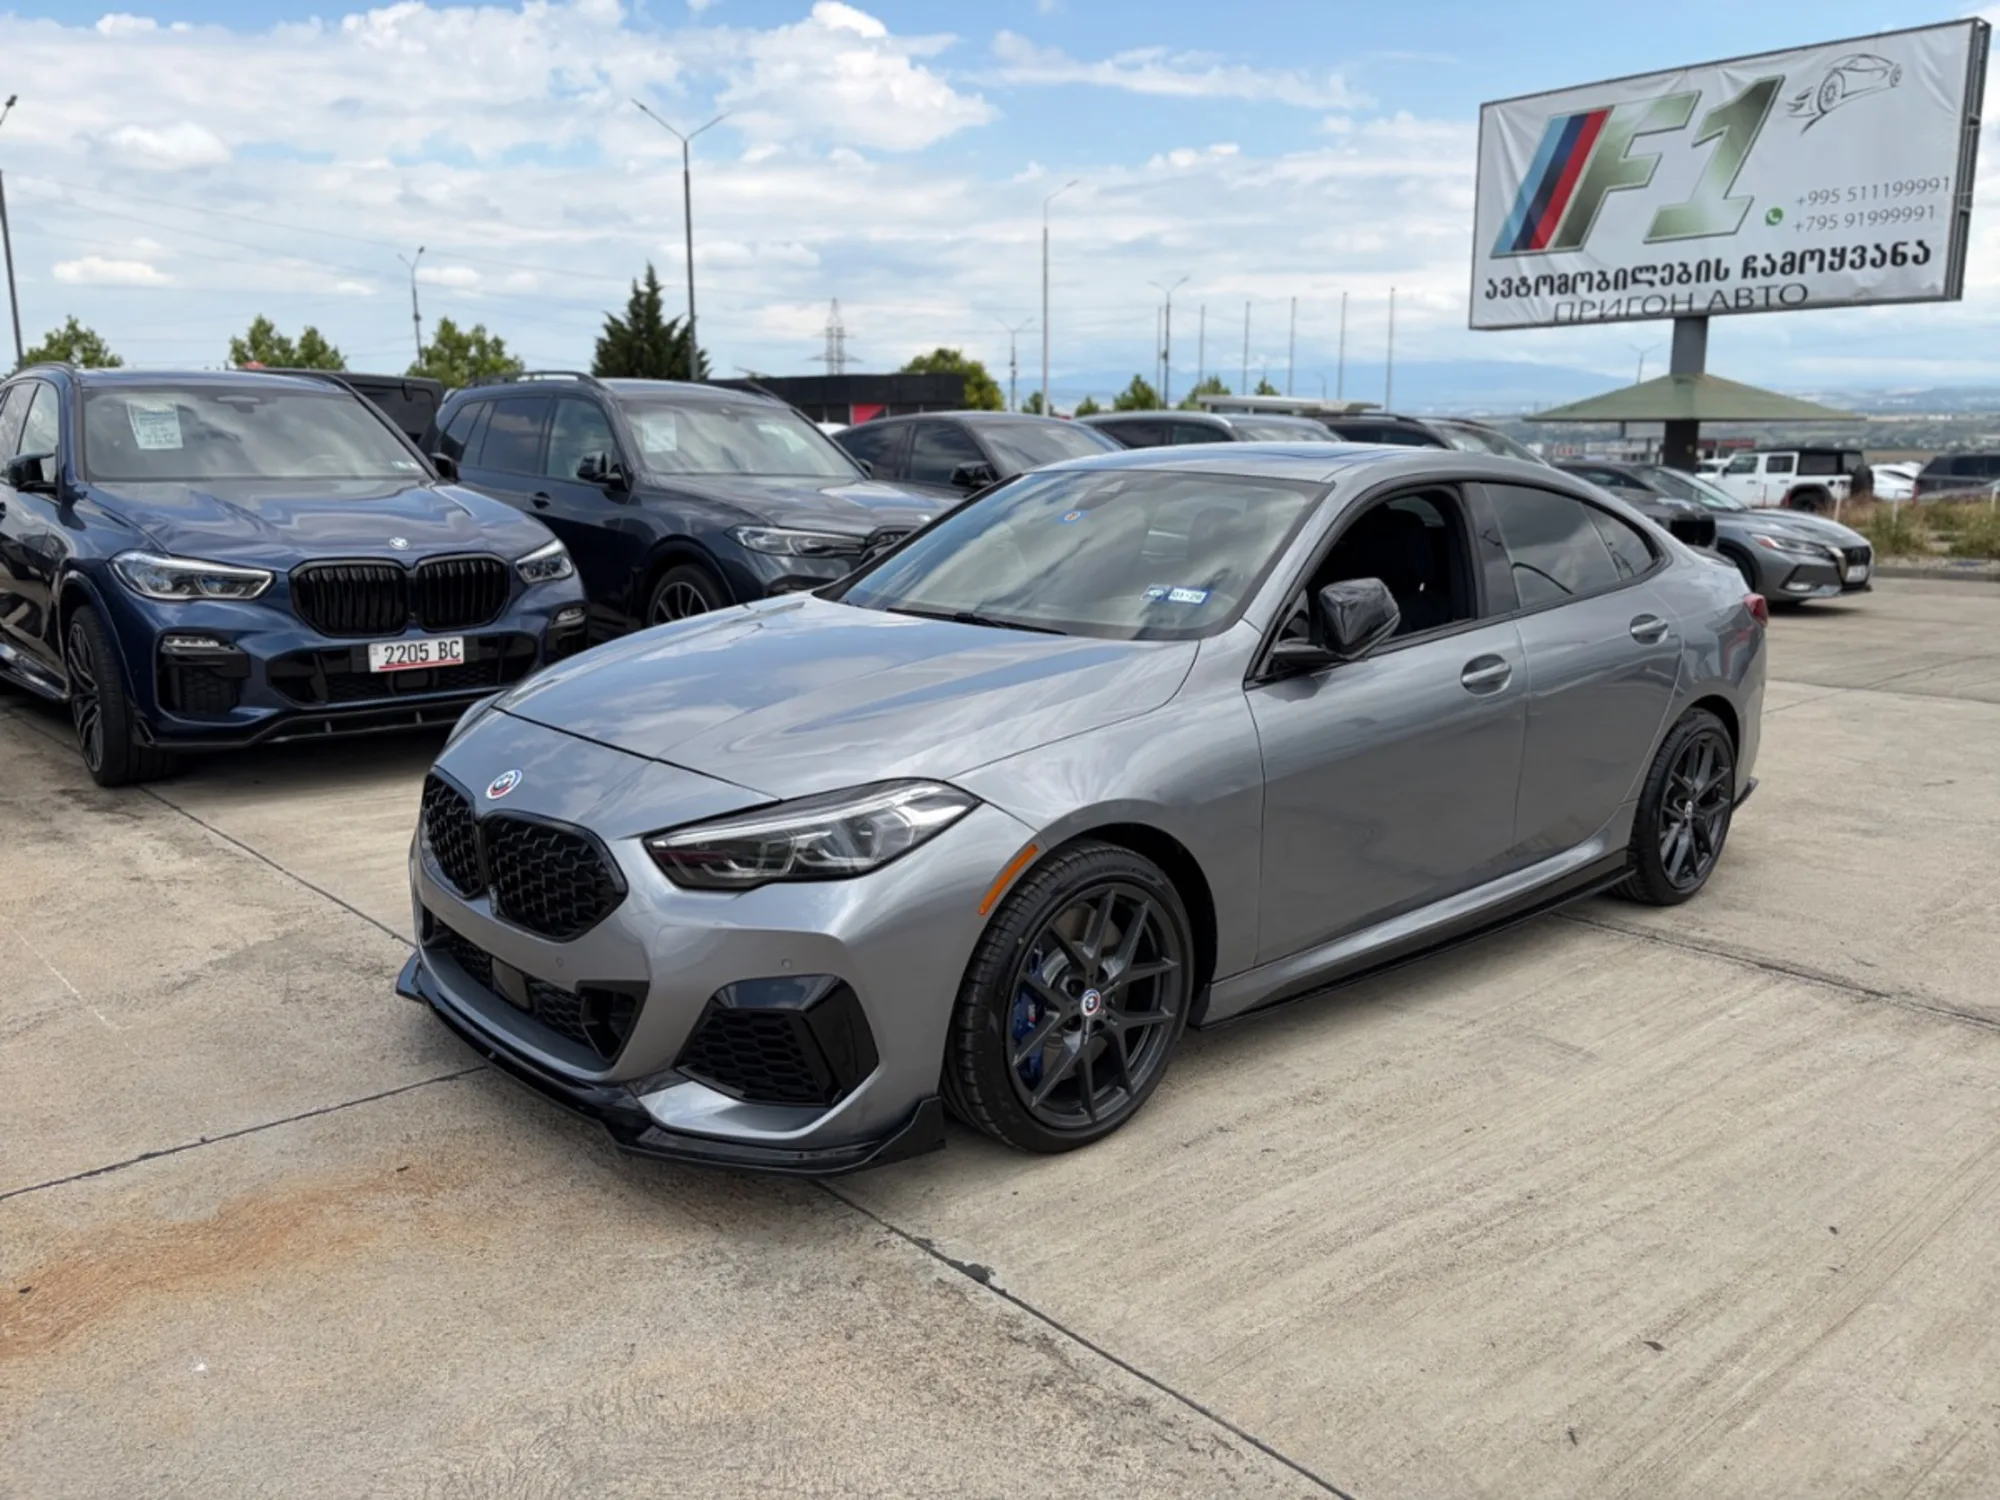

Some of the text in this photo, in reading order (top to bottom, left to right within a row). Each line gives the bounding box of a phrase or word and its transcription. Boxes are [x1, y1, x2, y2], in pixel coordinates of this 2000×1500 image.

[1796, 175, 1949, 207] +995 511199991
[1793, 204, 1935, 232] +795 91999991
[1485, 239, 1931, 300] ავტომობილების ჩამოყვანა
[1553, 283, 1808, 323] ПРИГОН АВТО
[384, 643, 430, 665] 2205
[438, 640, 461, 661] BC
